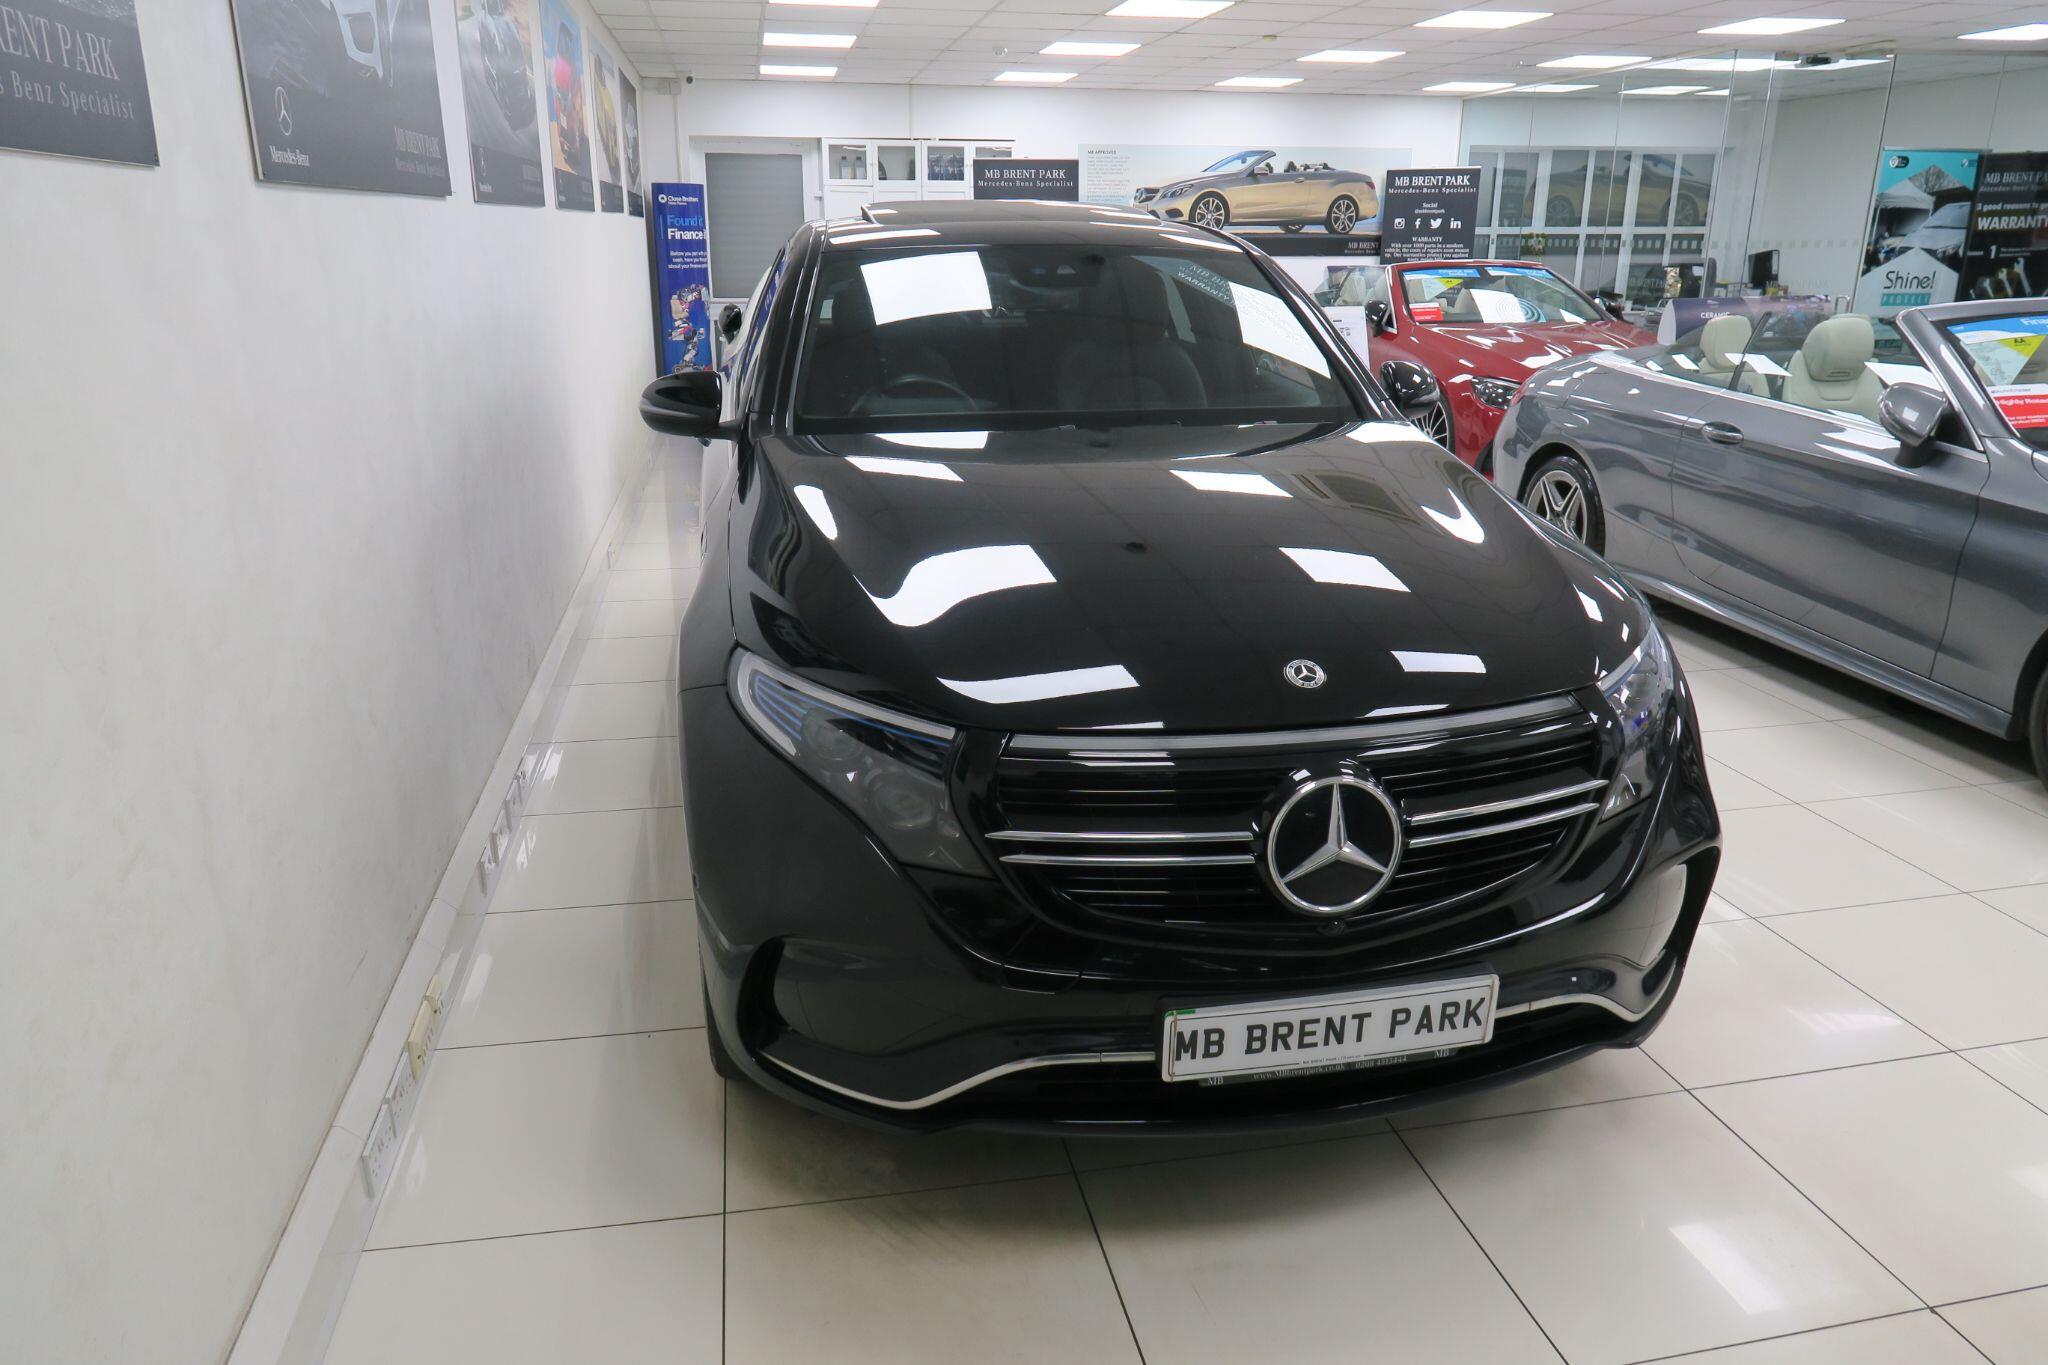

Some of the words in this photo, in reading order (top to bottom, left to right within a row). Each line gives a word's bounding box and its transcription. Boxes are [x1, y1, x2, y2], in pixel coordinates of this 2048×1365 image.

[55, 22, 120, 81] PARK
[10, 70, 54, 105] Benz
[59, 81, 135, 120] Specialist
[269, 145, 310, 167] Mercedes-Benz
[984, 169, 1000, 179] MB
[1004, 169, 1036, 179] BRENT
[1039, 169, 1066, 179] PARK
[1985, 172, 2000, 183] MB
[2003, 172, 2034, 183] BRENT
[1036, 180, 1073, 188] Specialist
[1395, 177, 1409, 187] MB
[1412, 176, 1443, 186] BRENT
[1445, 175, 1470, 186] PARK
[1983, 202, 2002, 212] good
[667, 214, 697, 227] Found
[668, 228, 702, 240] Finance
[1990, 245, 1996, 259] 1
[1883, 270, 1936, 290] Shine!
[1175, 1028, 1225, 1062] MB
[1245, 1012, 1372, 1056] BRENT
[1389, 997, 1487, 1039] PARK
[1433, 1049, 1450, 1059] MB
[1207, 1077, 1225, 1086] MB
